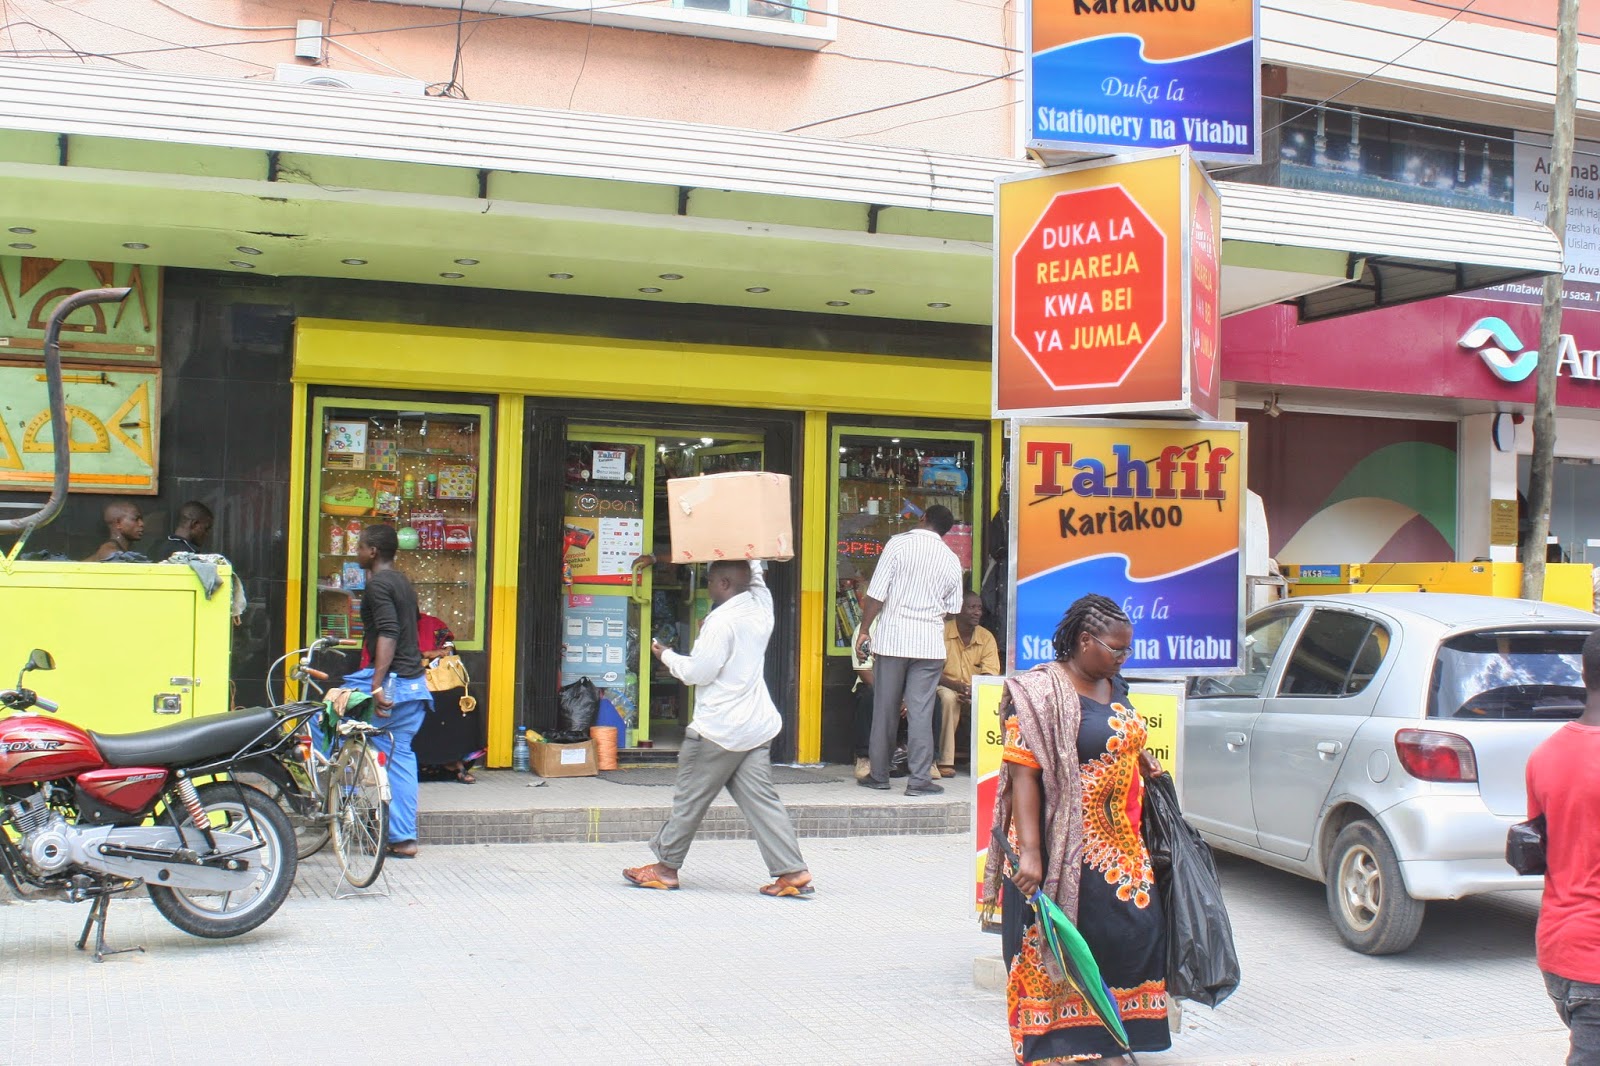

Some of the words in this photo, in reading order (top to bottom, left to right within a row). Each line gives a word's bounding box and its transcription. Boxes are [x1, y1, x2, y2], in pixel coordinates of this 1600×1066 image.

[1101, 76, 1160, 104] Duka
[1166, 79, 1185, 102] la
[1037, 106, 1143, 141] Stationery
[1150, 118, 1176, 141] na
[1182, 117, 1248, 145] Vitabu
[1042, 221, 1101, 249] DUKA
[1109, 216, 1135, 241] LA
[1036, 251, 1140, 285] REJAREJA
[1044, 291, 1094, 318] KWA
[1101, 287, 1132, 312] BEI
[1034, 329, 1063, 353] YA
[1069, 321, 1143, 350] JUMLA
[1026, 440, 1235, 500] Tahfif
[1058, 501, 1183, 539] Kariakoo
[1151, 596, 1169, 620] la
[1133, 639, 1160, 661] na
[1167, 635, 1232, 661] Vitabu
